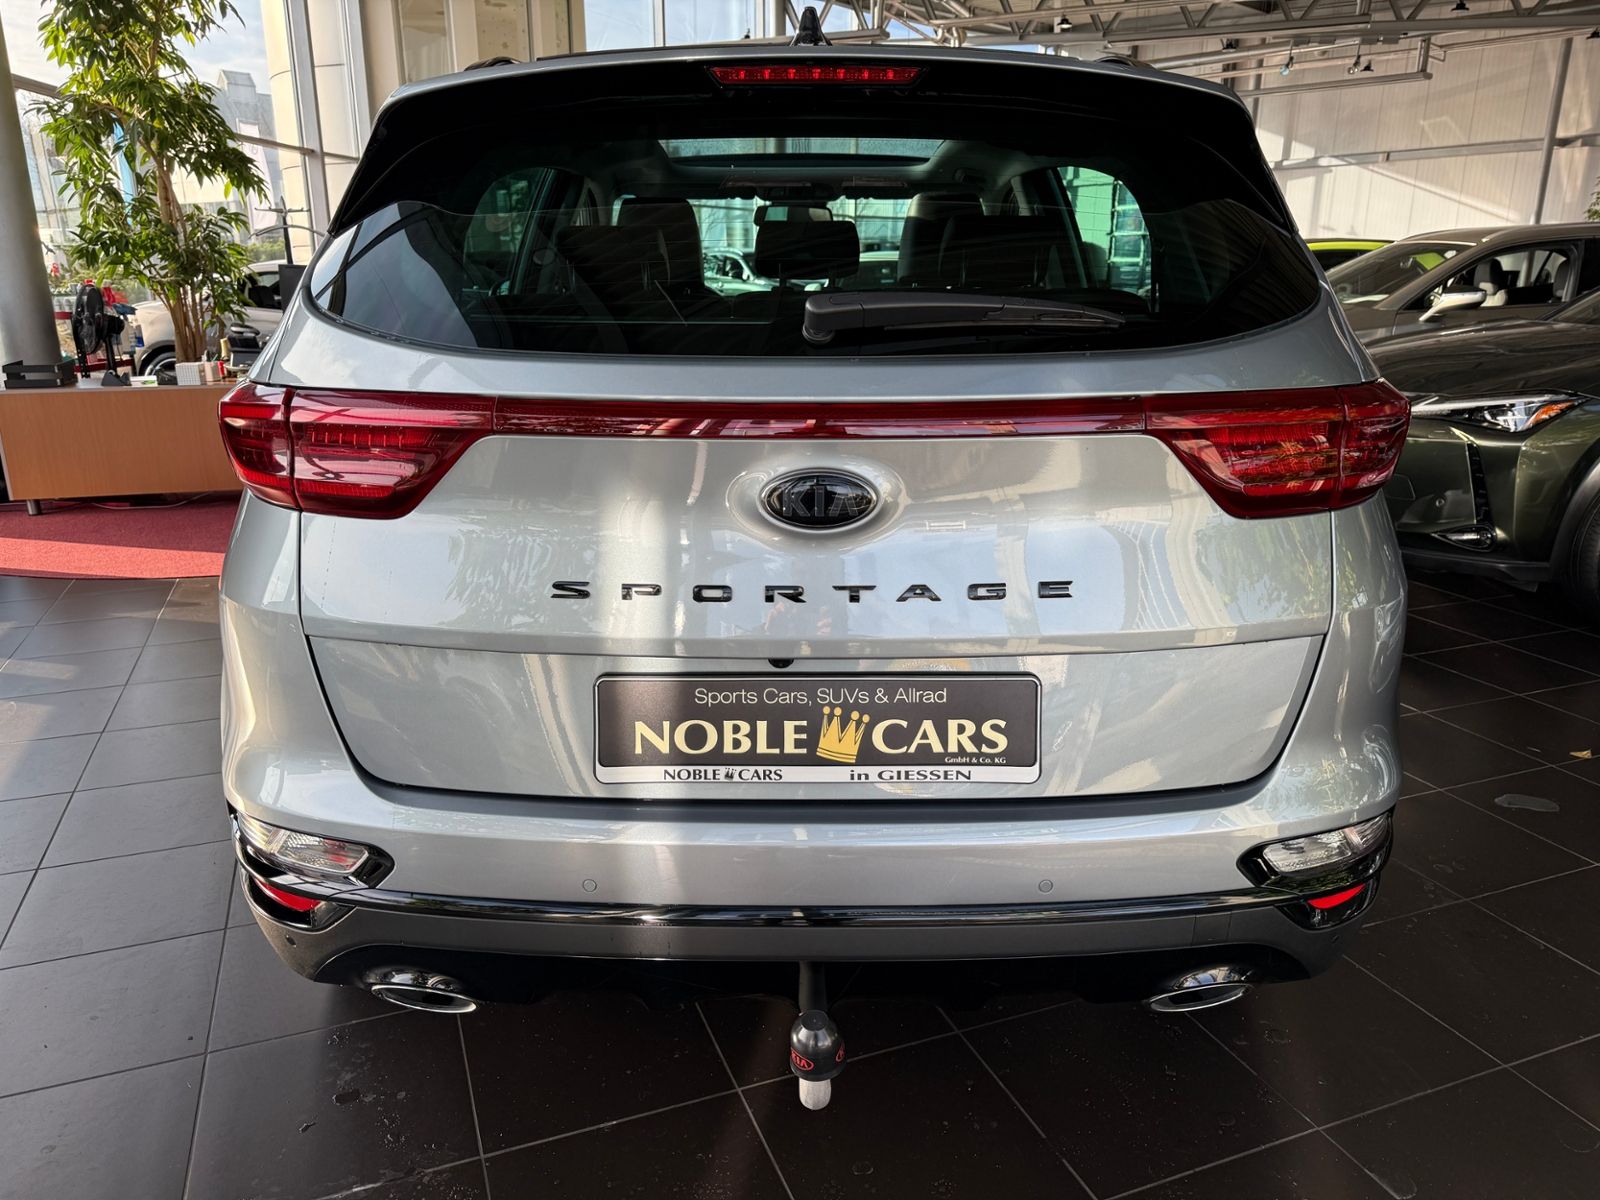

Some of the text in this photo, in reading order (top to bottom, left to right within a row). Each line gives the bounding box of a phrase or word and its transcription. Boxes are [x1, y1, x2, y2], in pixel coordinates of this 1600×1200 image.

[782, 485, 859, 517] KIA
[550, 580, 1074, 604] SPORTAGE
[694, 687, 947, 707] Sports Cars, SUVs & Allrad
[634, 718, 1009, 755] NOBLE CARS
[944, 756, 1007, 764] GmbH & Co. KG
[663, 768, 783, 781] NOBLE CARS
[849, 769, 972, 781] in GIESSEN
